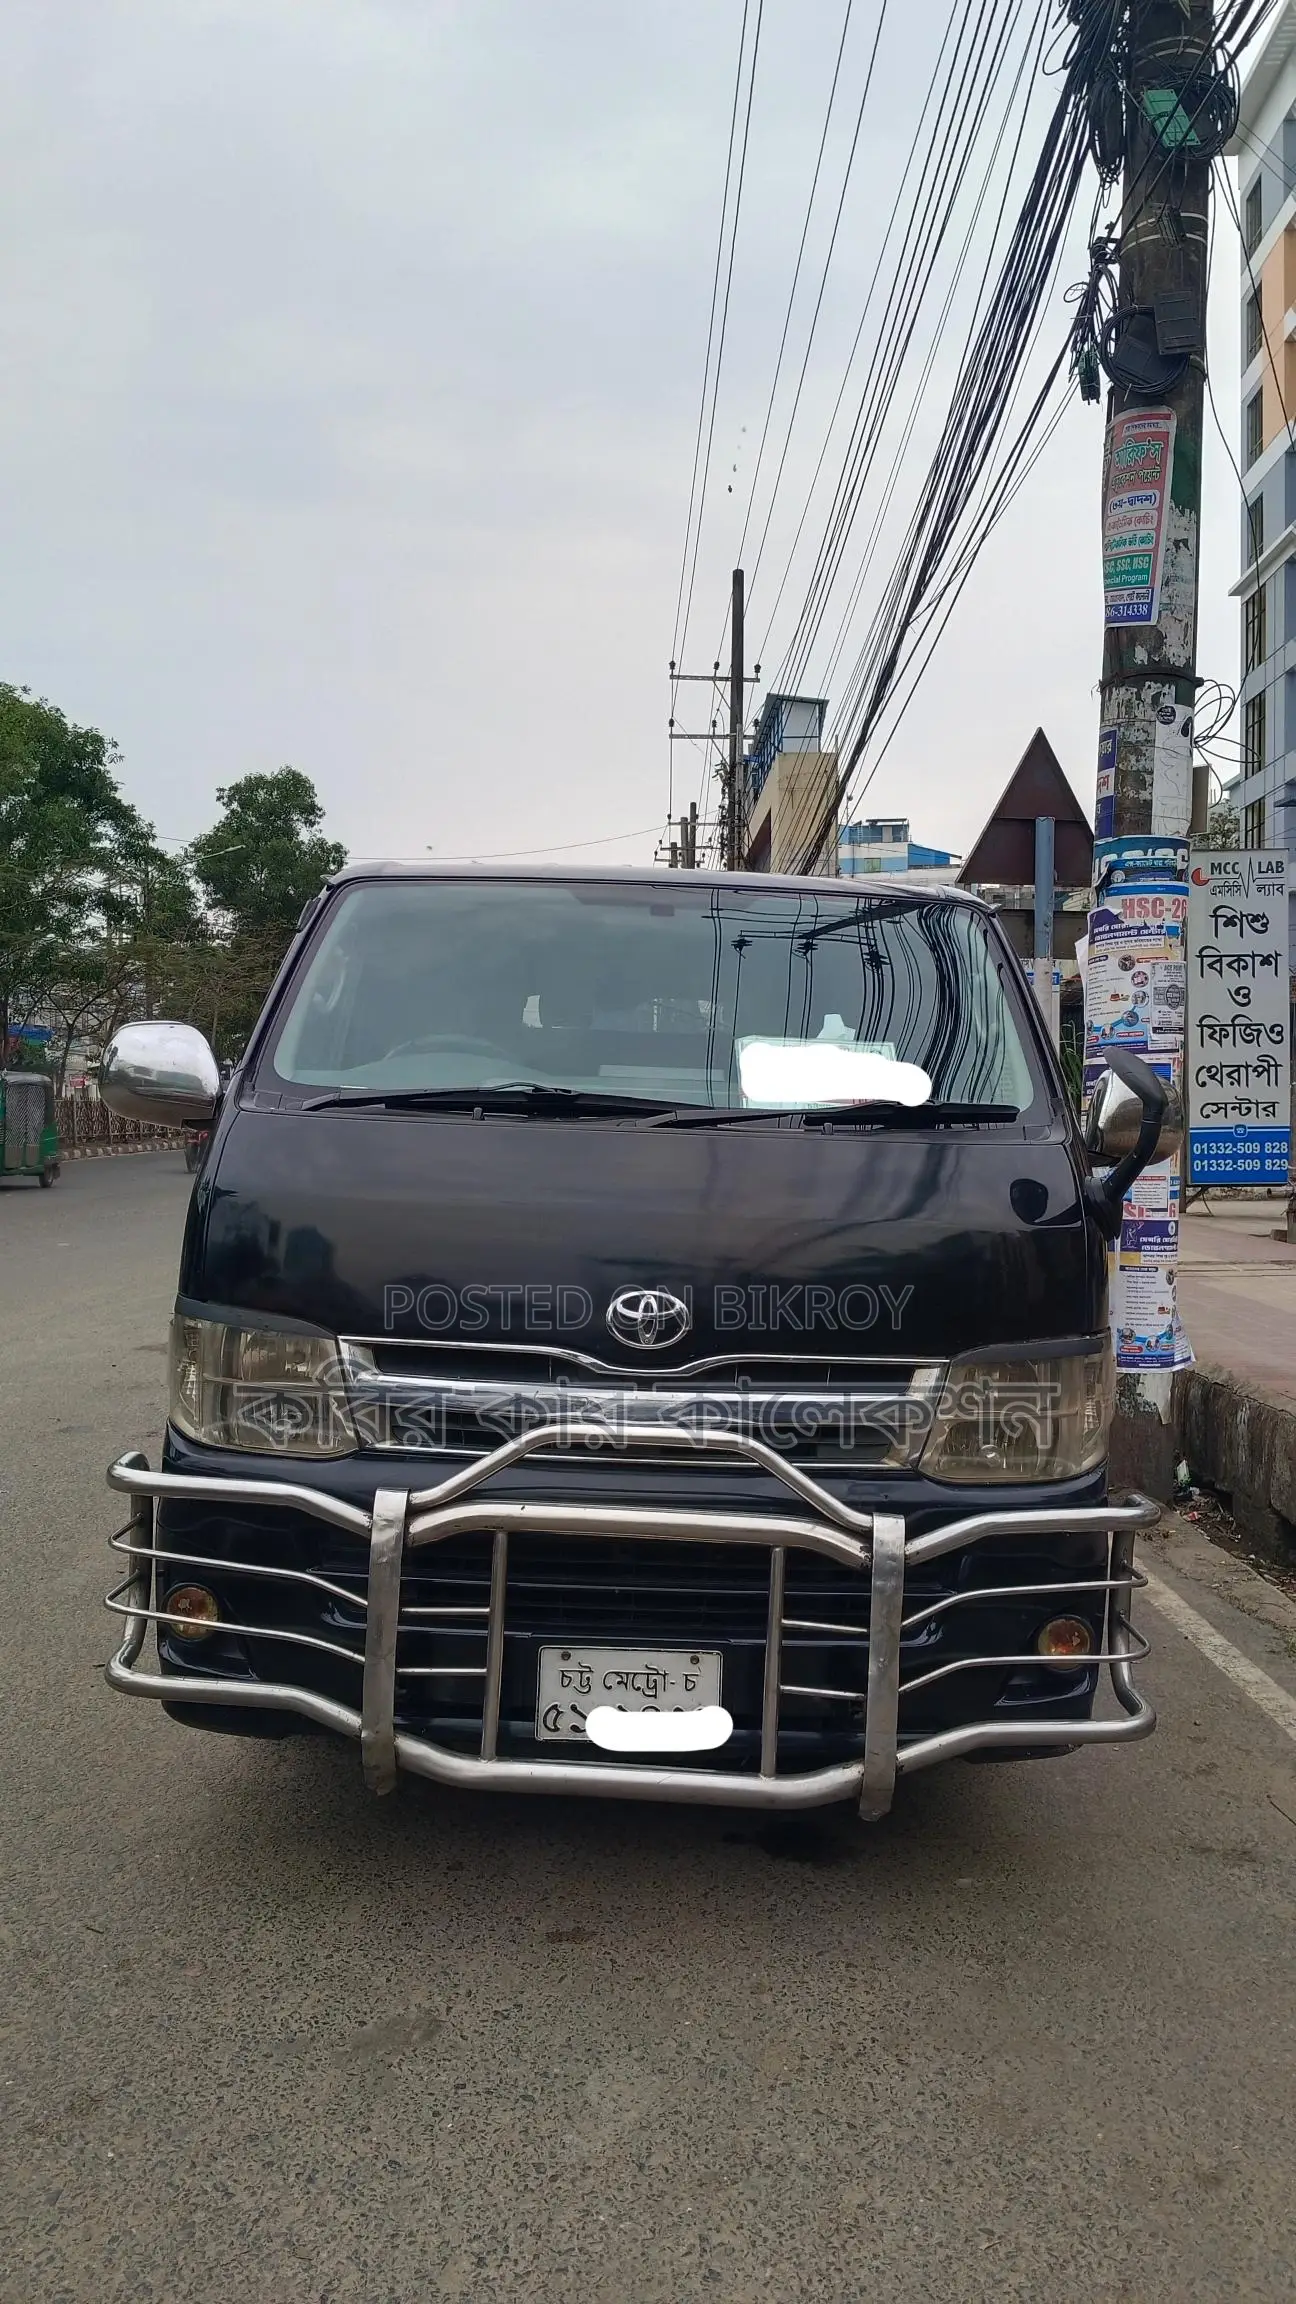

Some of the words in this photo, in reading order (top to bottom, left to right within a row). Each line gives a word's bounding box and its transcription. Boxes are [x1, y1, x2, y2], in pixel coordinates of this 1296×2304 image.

[1132, 556, 1150, 570] HSC
[1121, 574, 1148, 584] Program
[1210, 861, 1240, 876] MCC
[1257, 860, 1285, 874] LAB
[1210, 881, 1242, 897] এমসিসি
[1256, 883, 1286, 897] ল্যাব
[1121, 896, 1188, 919] HSC-26
[1208, 904, 1270, 939] শিশু
[1195, 945, 1283, 979] বিকাশ
[1227, 985, 1252, 1008] ও
[1195, 1014, 1285, 1048] ফিজিও
[1195, 1054, 1283, 1088] থেরাপী
[1200, 1095, 1280, 1119] সেন্টার
[1193, 1142, 1261, 1155] 01332-509
[1264, 1141, 1288, 1154] 828
[1193, 1159, 1261, 1172] 01332-509
[1264, 1158, 1289, 1171] 829
[682, 1672, 700, 1692] চ
